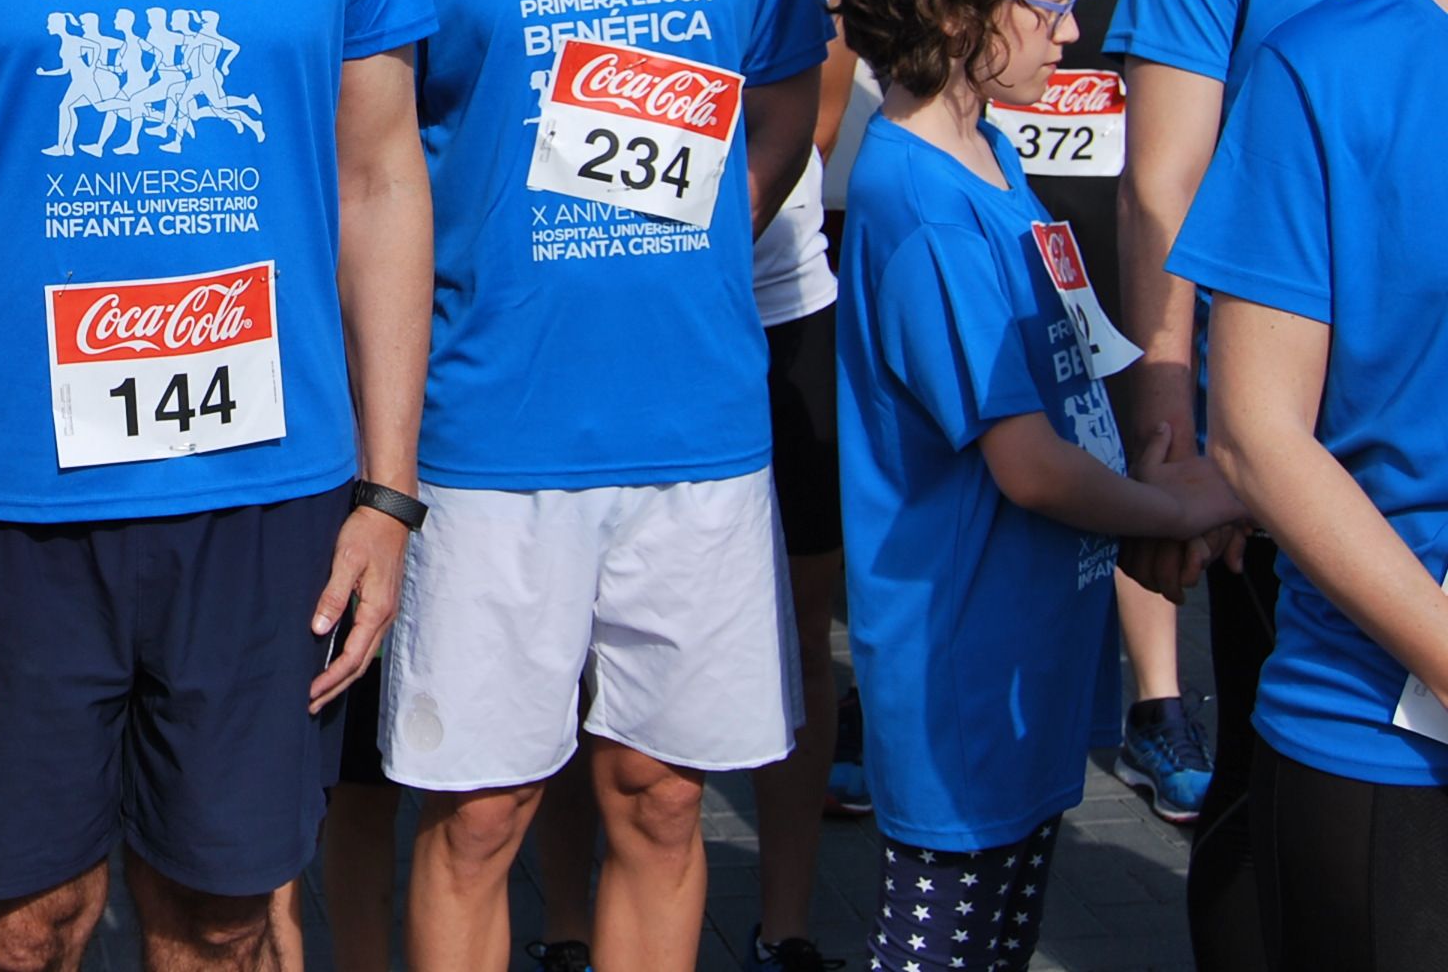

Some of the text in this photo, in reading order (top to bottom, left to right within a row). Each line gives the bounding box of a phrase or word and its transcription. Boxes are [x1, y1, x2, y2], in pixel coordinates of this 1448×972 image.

[570, 53, 730, 128] Coca-Cola
[1016, 124, 1094, 160] 372
[577, 128, 692, 199] 234
[46, 167, 260, 197] X ANIVERSARIO
[46, 196, 258, 216] HOSPITAL UNIVERSITARIO
[531, 205, 548, 226] X
[45, 213, 259, 238] INFANTA CRISTINA
[532, 227, 609, 242] HOSPITAL
[533, 232, 710, 261] INFANTA CRISTINA
[76, 276, 254, 355] Coca-Cola
[110, 365, 237, 437] 144
